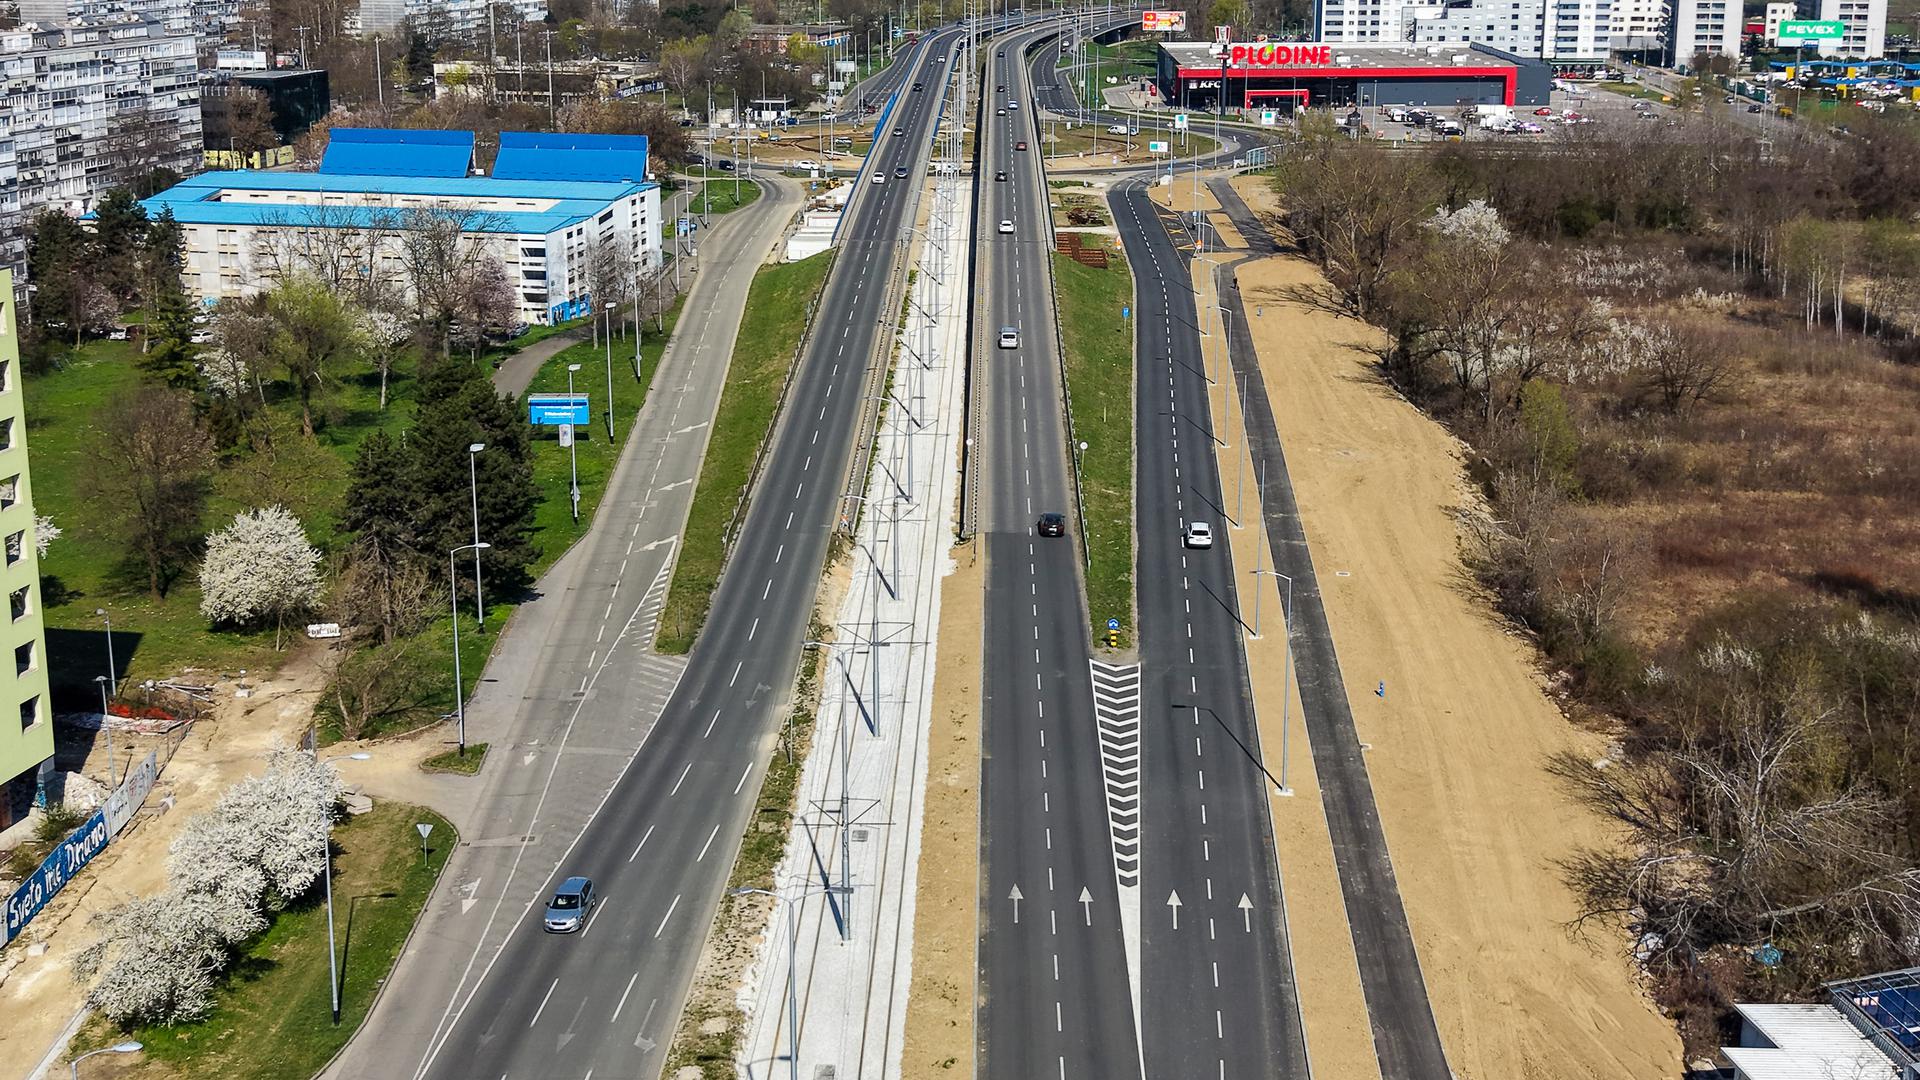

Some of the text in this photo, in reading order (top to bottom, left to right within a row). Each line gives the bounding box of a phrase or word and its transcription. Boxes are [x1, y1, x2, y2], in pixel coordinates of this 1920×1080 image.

[1786, 25, 1836, 34] PEVEX
[1232, 45, 1331, 65] PLODINE
[1199, 80, 1221, 89] KFC
[9, 879, 42, 928] Sveto
[64, 822, 105, 873] Dinamo
